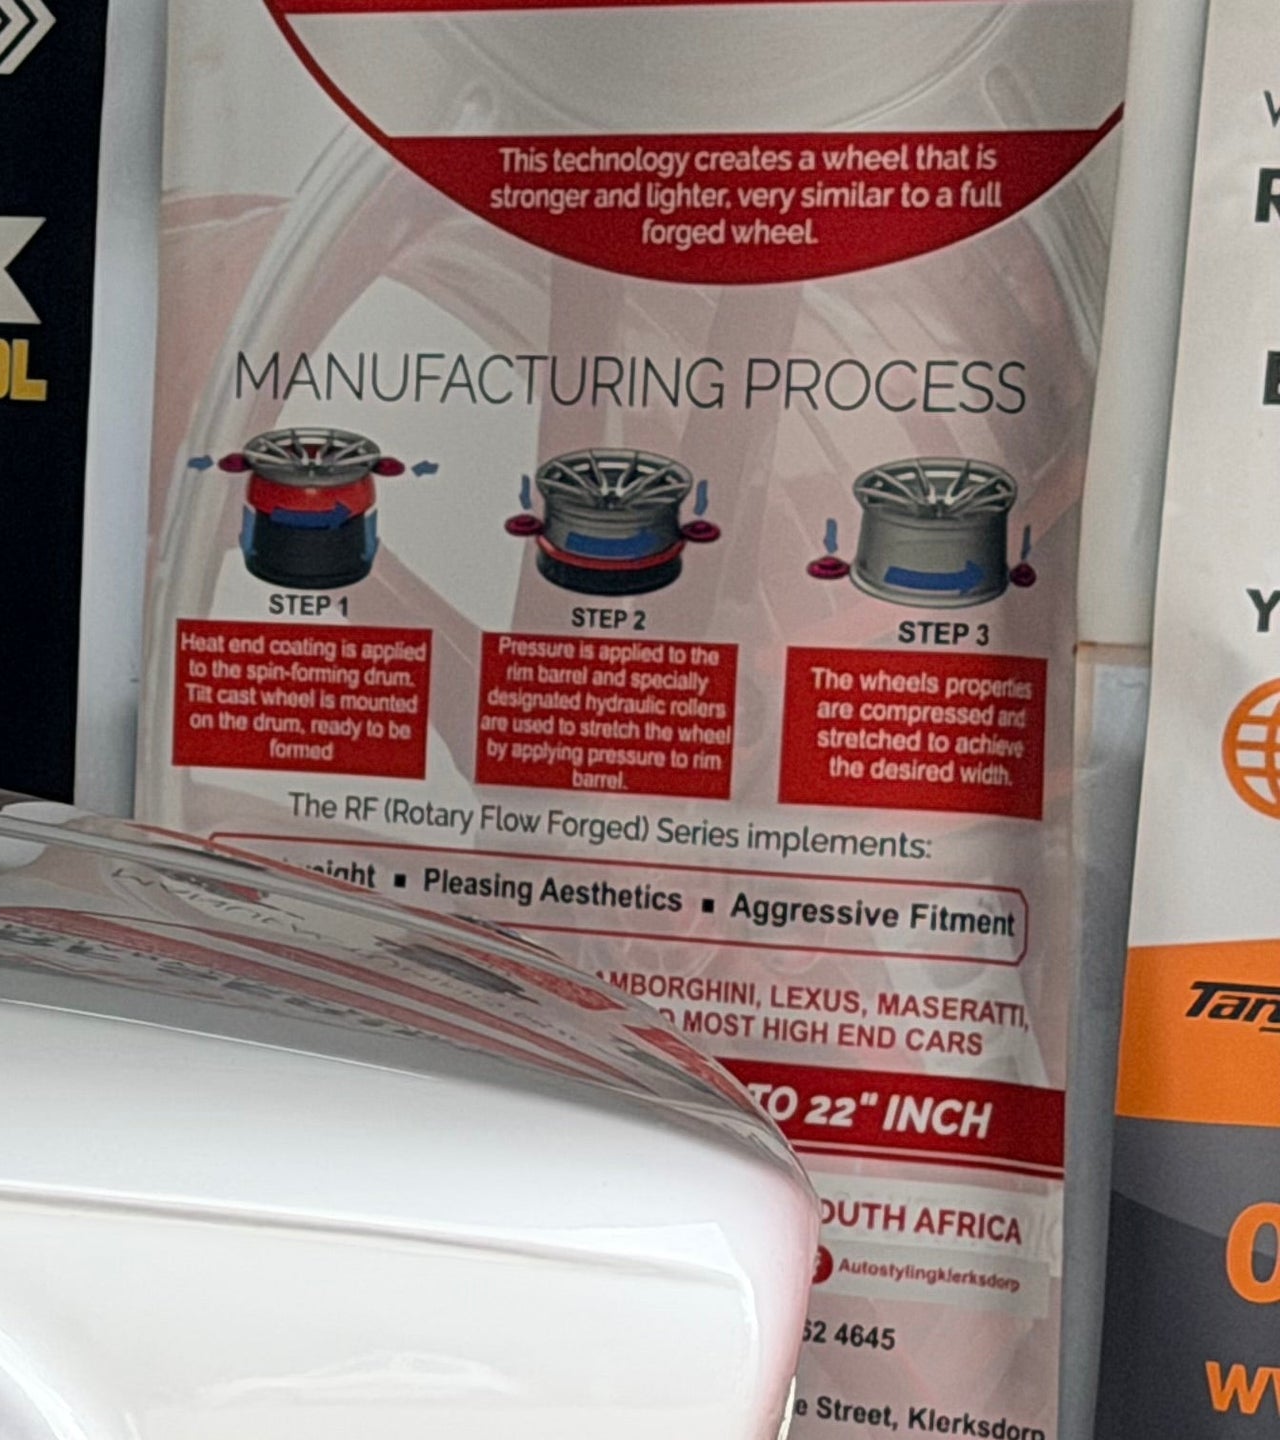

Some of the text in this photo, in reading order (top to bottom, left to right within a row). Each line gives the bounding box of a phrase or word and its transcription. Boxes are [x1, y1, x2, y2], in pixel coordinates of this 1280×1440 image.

[499, 144, 997, 179] This technology creates a wheel that is
[490, 184, 588, 215] stronger
[593, 182, 640, 209] and
[738, 187, 794, 215] very
[800, 182, 895, 208] similar
[900, 185, 930, 208] to
[936, 188, 953, 208] a
[960, 181, 1003, 208] full
[642, 218, 820, 251] forged wheel.
[236, 350, 1027, 414] MANUFACTURING PROCESS
[268, 593, 349, 617] STEP 1
[571, 607, 646, 631] STEP 2
[180, 632, 427, 663] Heat end coating is applied
[898, 620, 990, 646] STEP 3
[498, 636, 720, 666] Pressure is applied to the
[189, 660, 416, 689] to the spin-forming drum.
[506, 661, 710, 695] rim barrel and specially
[811, 666, 1033, 701] The wheels properties
[216, 687, 257, 706] cast
[260, 688, 315, 708] wheel
[320, 690, 335, 709] is
[340, 693, 418, 714] mounted
[487, 688, 727, 719] designated hydraulic rollers
[817, 701, 1027, 728] are compressed and
[190, 713, 213, 729] on
[218, 711, 248, 731] the
[310, 717, 363, 741] ready
[366, 719, 384, 737] to
[389, 720, 412, 740] be
[480, 714, 732, 746] are used to stretch the wheel
[269, 738, 335, 761] formed
[486, 738, 722, 770] by applying pressure to rim
[817, 727, 1025, 759] stretched to achieve
[572, 768, 629, 791] barrel.
[829, 755, 1013, 786] the desired width.
[288, 791, 933, 860] The RF (Rotary Flow Forged) Series implements:
[423, 867, 1016, 938] Pleasing Aesthetics Aggressive Fitment
[770, 985, 869, 1018] LEXUS,
[877, 992, 1030, 1033] MASERATTI,
[683, 1009, 756, 1038] MOST
[762, 1016, 829, 1045] HIGH
[837, 1023, 897, 1051] END
[906, 1027, 984, 1057] CARS
[747, 1082, 798, 1121] TO
[882, 1093, 994, 1139] INCH
[820, 1198, 1023, 1245] OUTH AFRICA
[834, 1322, 896, 1351] 4645
[816, 1396, 899, 1431] Street,
